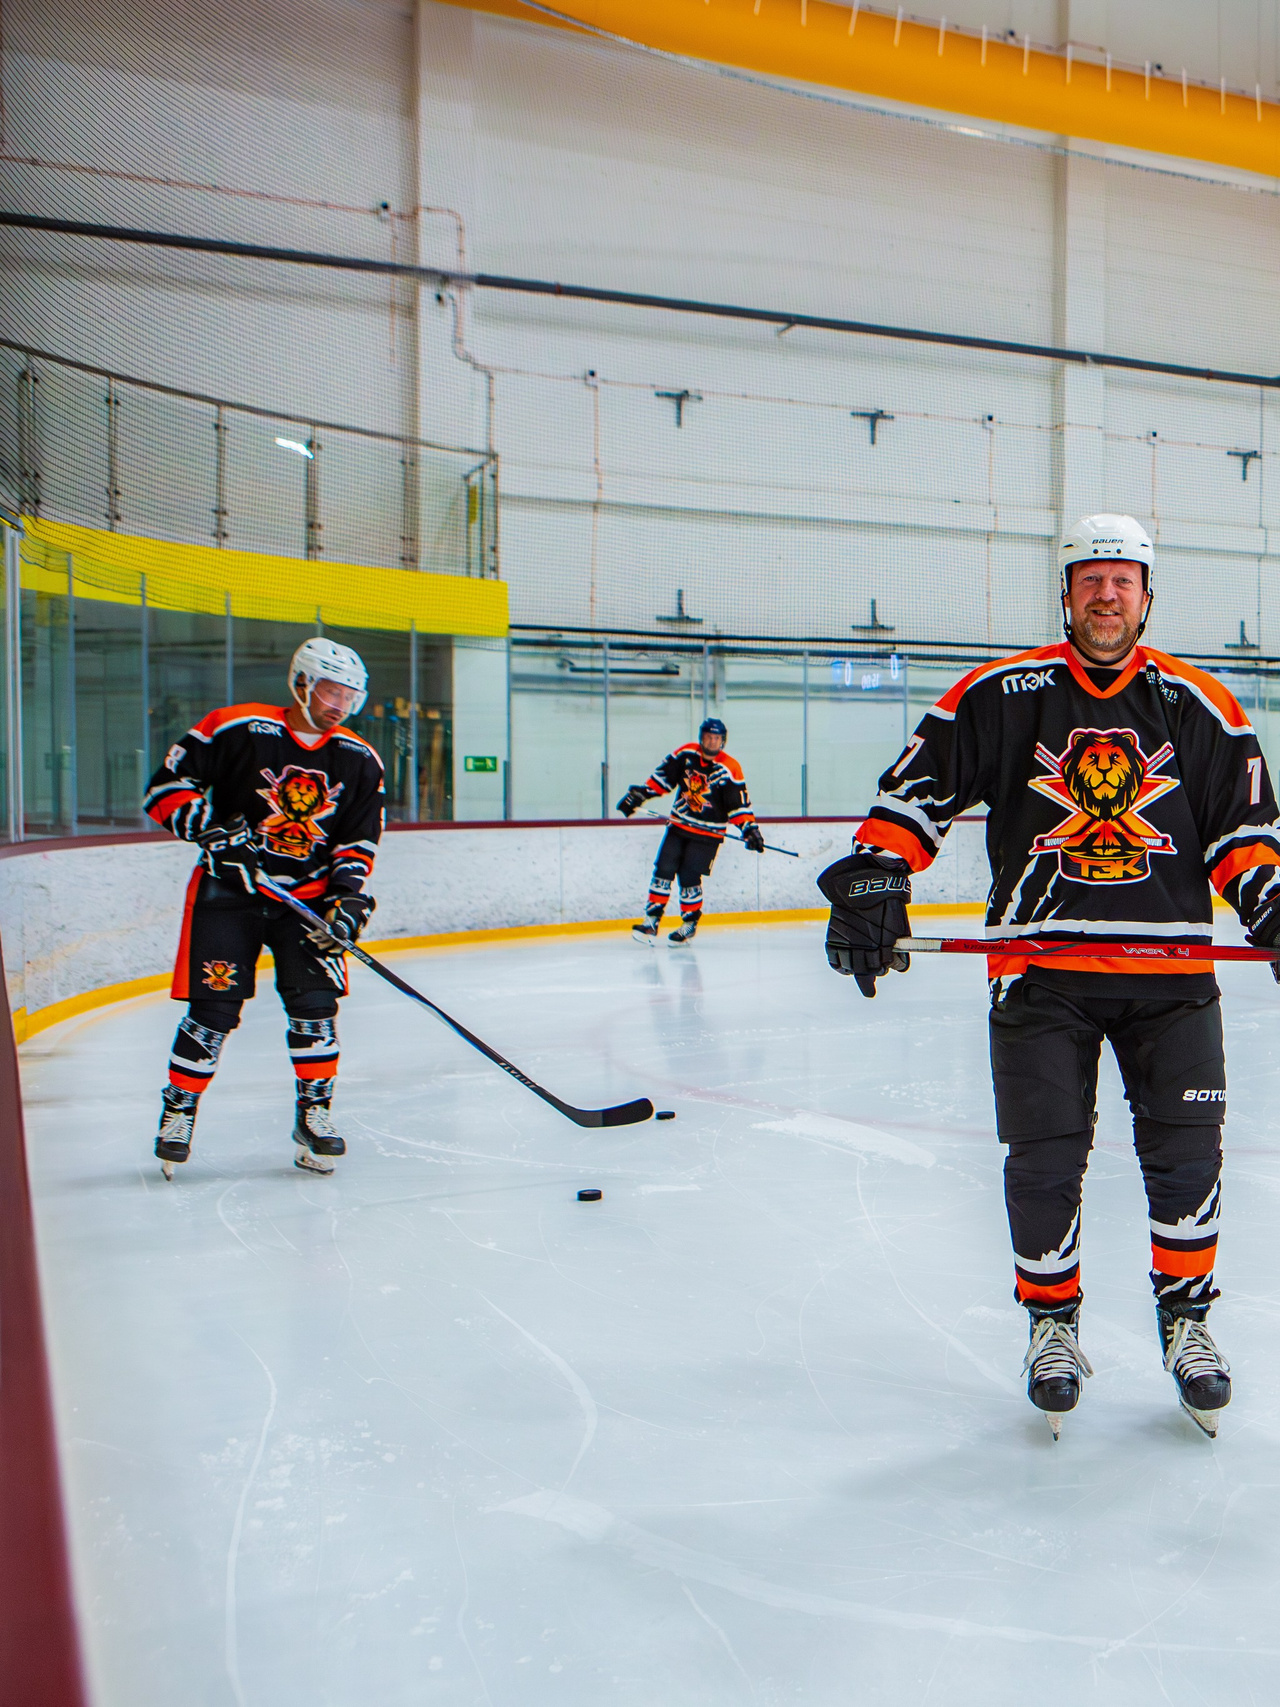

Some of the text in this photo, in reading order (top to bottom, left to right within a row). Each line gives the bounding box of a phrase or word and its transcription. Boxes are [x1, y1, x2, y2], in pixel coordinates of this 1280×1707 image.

[891, 734, 925, 778] 7
[1246, 756, 1262, 805] 7
[1067, 854, 1144, 879] ТЭК
